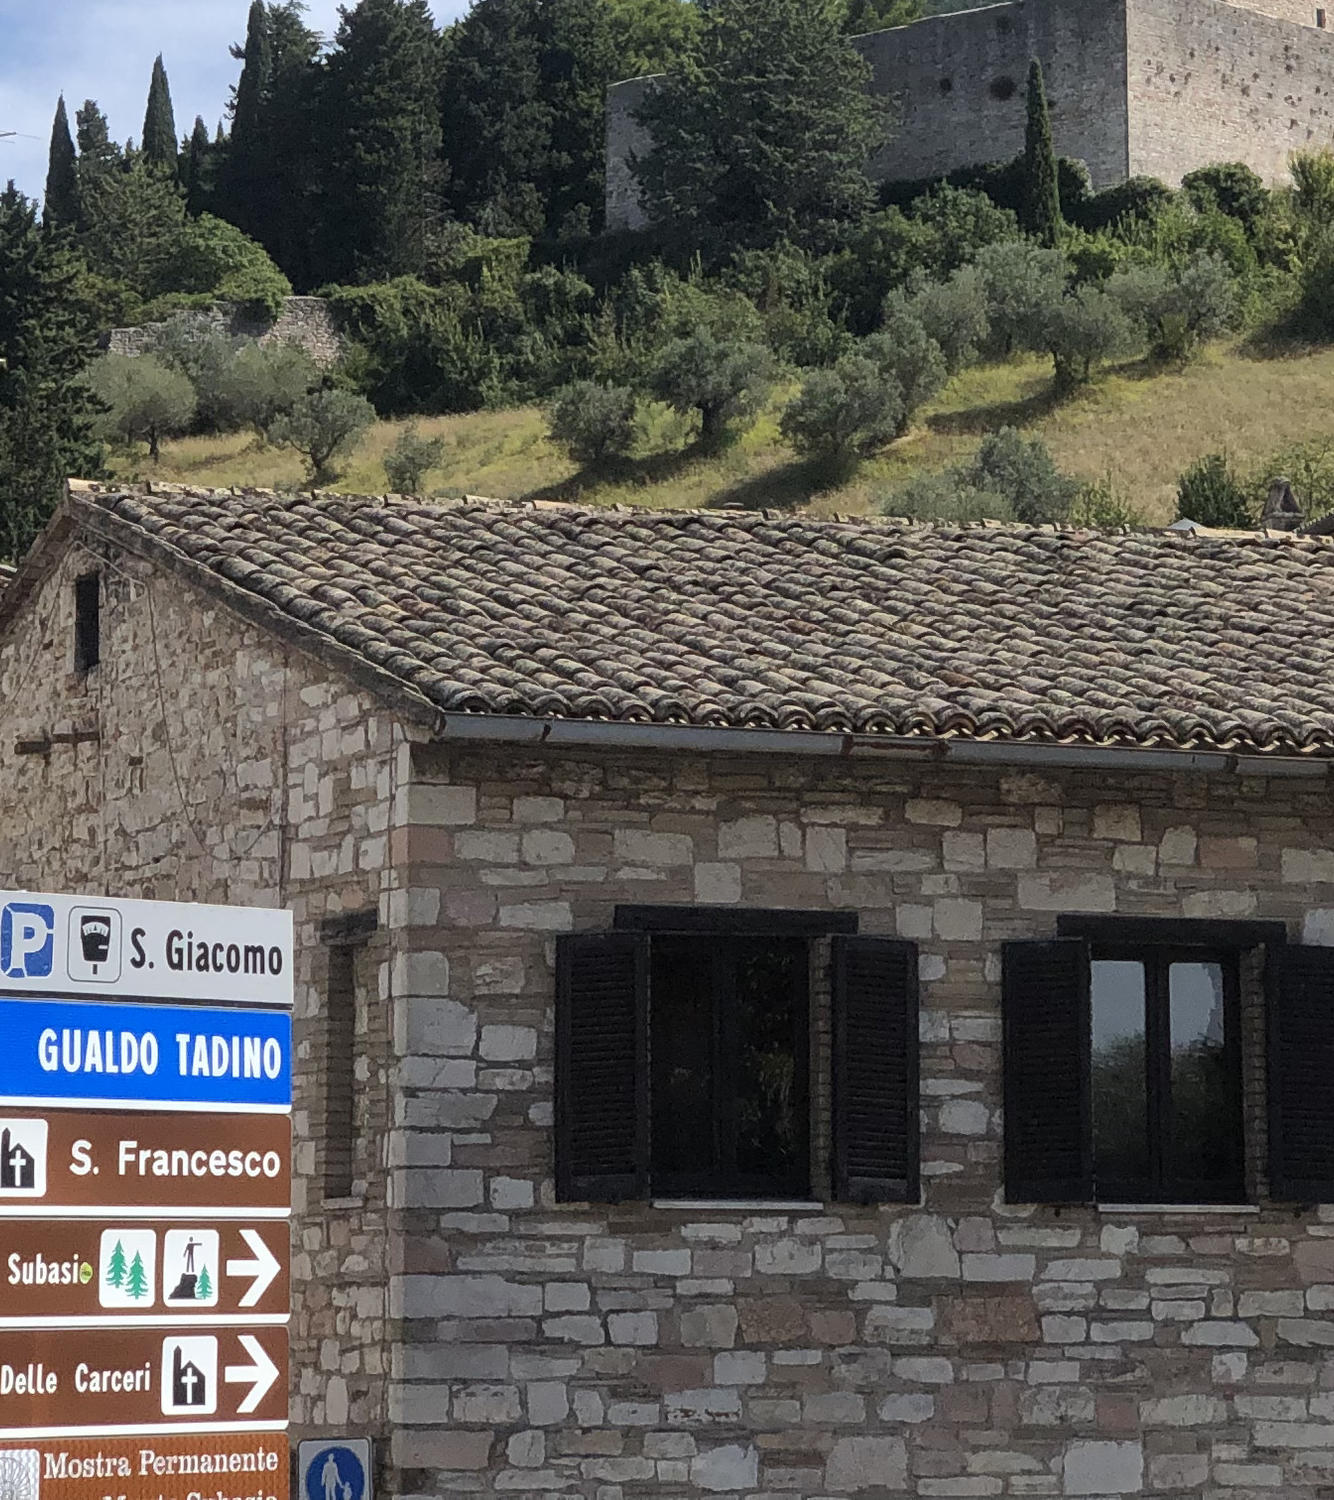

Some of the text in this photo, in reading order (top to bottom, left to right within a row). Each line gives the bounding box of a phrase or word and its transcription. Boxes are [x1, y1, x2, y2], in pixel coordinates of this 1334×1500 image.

[130, 928, 283, 975] S. Giacomo
[38, 1028, 281, 1080] GUALDO TADINO
[69, 1140, 280, 1177] S. Francesco
[0, 1364, 57, 1395] Delle
[75, 1362, 151, 1394] Carceri
[43, 1446, 278, 1479] Mostra Permanente
